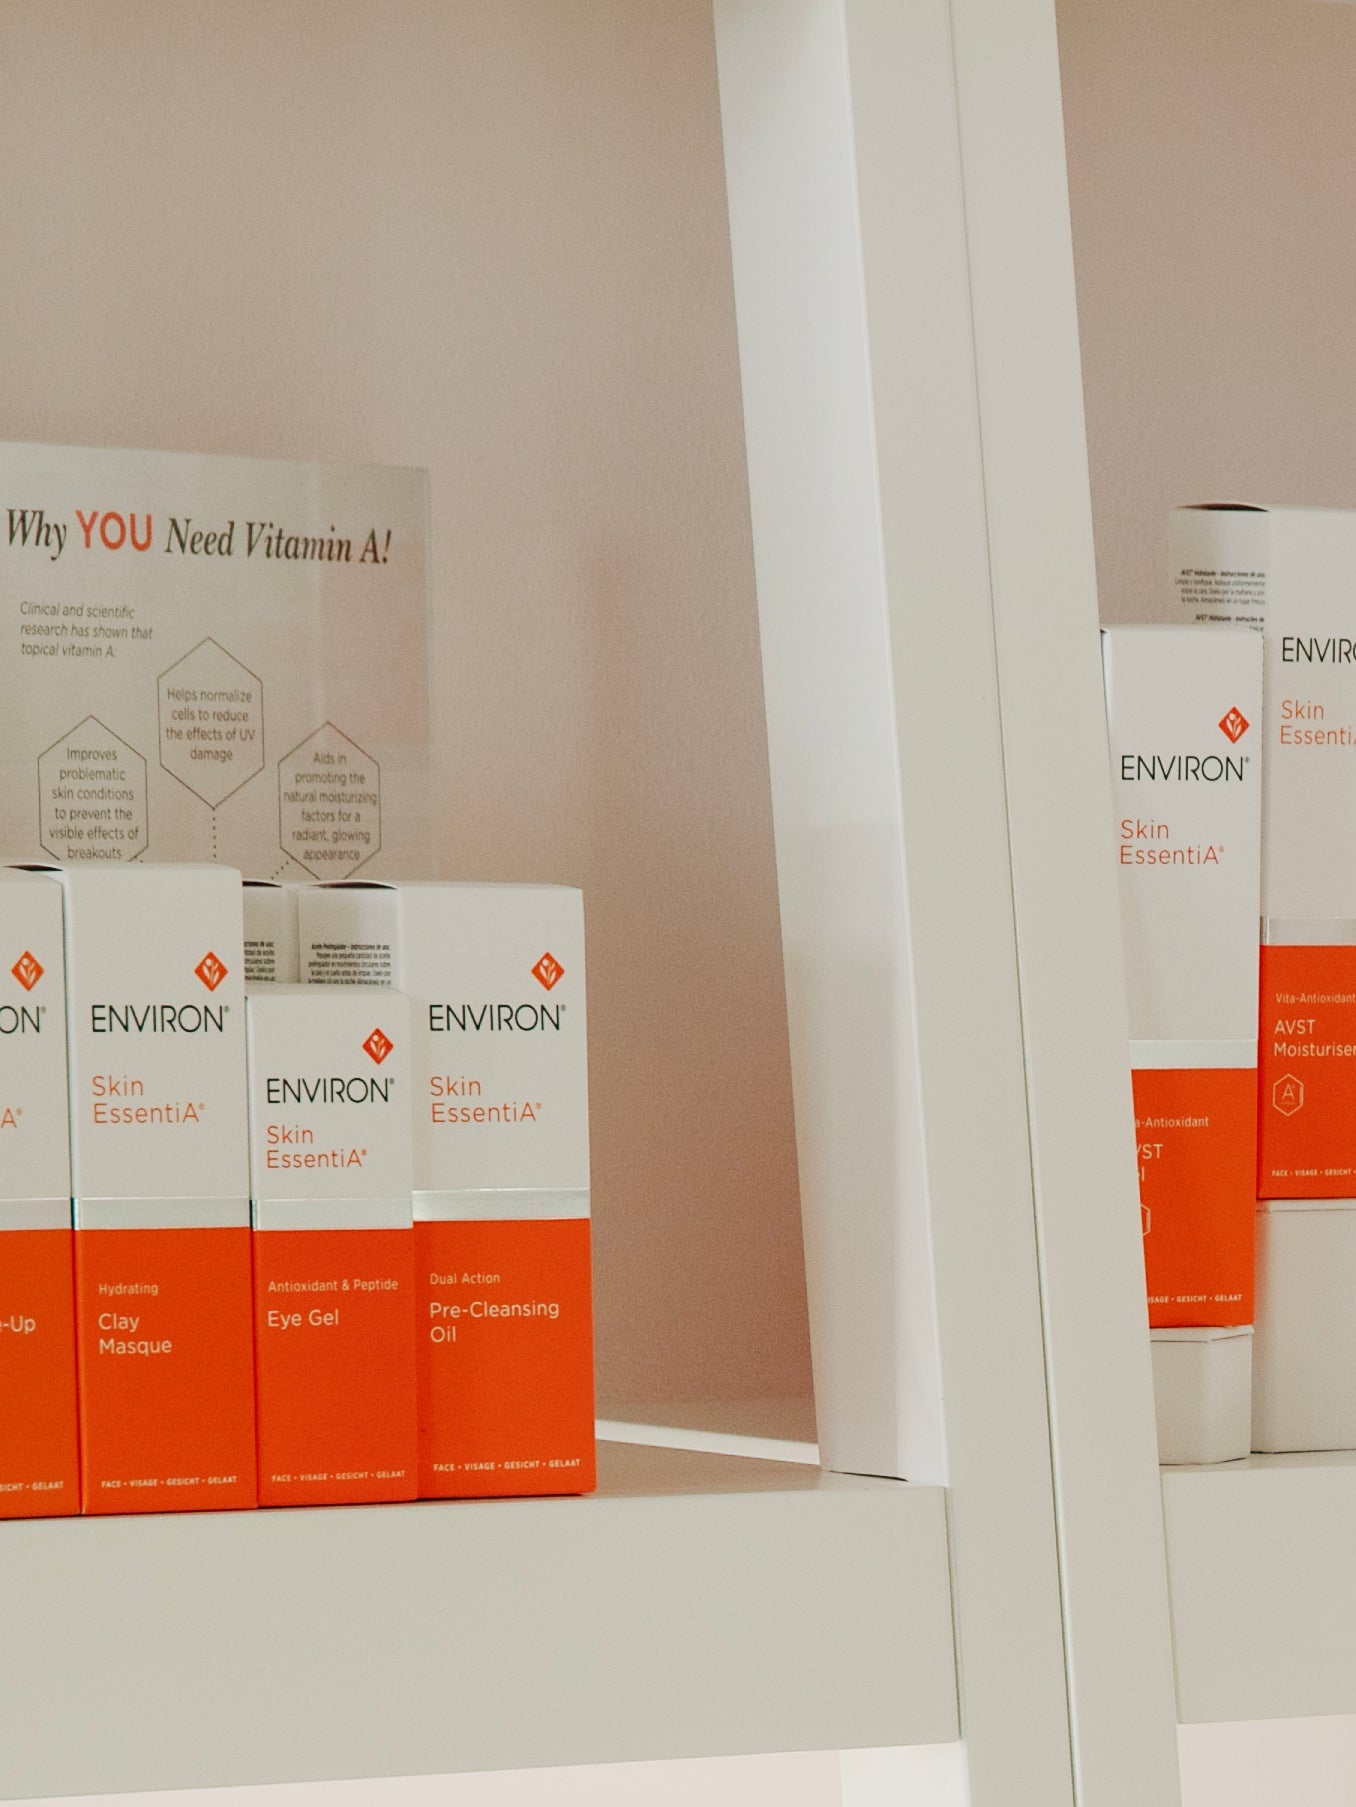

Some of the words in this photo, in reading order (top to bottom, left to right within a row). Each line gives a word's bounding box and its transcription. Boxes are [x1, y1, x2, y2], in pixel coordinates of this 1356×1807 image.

[8, 509, 66, 561] Why
[76, 511, 152, 551] YOU
[165, 518, 234, 556] Need
[247, 522, 351, 562] Vitamin
[360, 529, 391, 563] A!
[20, 601, 60, 616] Clinical
[62, 605, 84, 617] and
[87, 605, 134, 619] scientific
[21, 624, 68, 636] research
[71, 624, 89, 637] has
[93, 626, 128, 638] shown
[132, 627, 153, 639] that
[21, 643, 59, 656] topical
[62, 644, 102, 656] vitamin
[167, 688, 197, 703] Helps
[200, 690, 252, 703] normalize
[172, 708, 195, 721] cells
[198, 710, 209, 721] to
[213, 710, 248, 722] reduce
[1282, 700, 1324, 719] Skin
[166, 727, 183, 740] the
[186, 727, 222, 740] effects
[225, 728, 236, 741] of
[240, 729, 255, 741] UV
[67, 747, 117, 761] Improves
[190, 747, 233, 763] damage
[313, 752, 335, 764] Aids
[338, 755, 347, 764] in
[60, 767, 125, 781] problematic
[295, 772, 347, 787] promoting
[349, 773, 365, 785] the
[52, 787, 74, 799] skin
[77, 788, 134, 801] conditions
[284, 791, 316, 802] natural
[319, 792, 377, 806] moisturizing
[55, 808, 66, 820] to
[70, 808, 111, 821] prevent
[115, 808, 133, 820] the
[301, 809, 335, 822] factors
[338, 809, 351, 822] for
[354, 812, 360, 823] a
[49, 826, 84, 839] visible
[87, 826, 125, 840] effects
[128, 826, 139, 840] of
[332, 829, 370, 844] glowing
[1121, 820, 1168, 839] Skin
[67, 846, 122, 859] breakouts
[303, 850, 360, 861] appearance
[1276, 993, 1355, 1003] Vita-Antioxidant
[1275, 1019, 1315, 1034] AVST
[92, 1075, 143, 1096] Skin
[430, 1076, 481, 1096] Skin
[267, 1125, 313, 1144] Skin
[268, 1281, 337, 1292] Antioxidant
[341, 1279, 350, 1292] &
[354, 1279, 398, 1291] Peptide
[430, 1273, 457, 1285] Dual
[462, 1273, 500, 1284] Action
[99, 1283, 158, 1296] Hydrating
[430, 1301, 559, 1319] Pre-Cleansing
[98, 1313, 139, 1332] Clay
[268, 1311, 301, 1329] Eye
[309, 1309, 338, 1326] Gel
[430, 1326, 456, 1343] Oil
[99, 1338, 172, 1356] Masque
[433, 1462, 455, 1472] FACE
[465, 1462, 495, 1470] VISAGE
[504, 1461, 539, 1469] GESICHT
[549, 1459, 580, 1467] GELAAT
[101, 1480, 121, 1488] FACE
